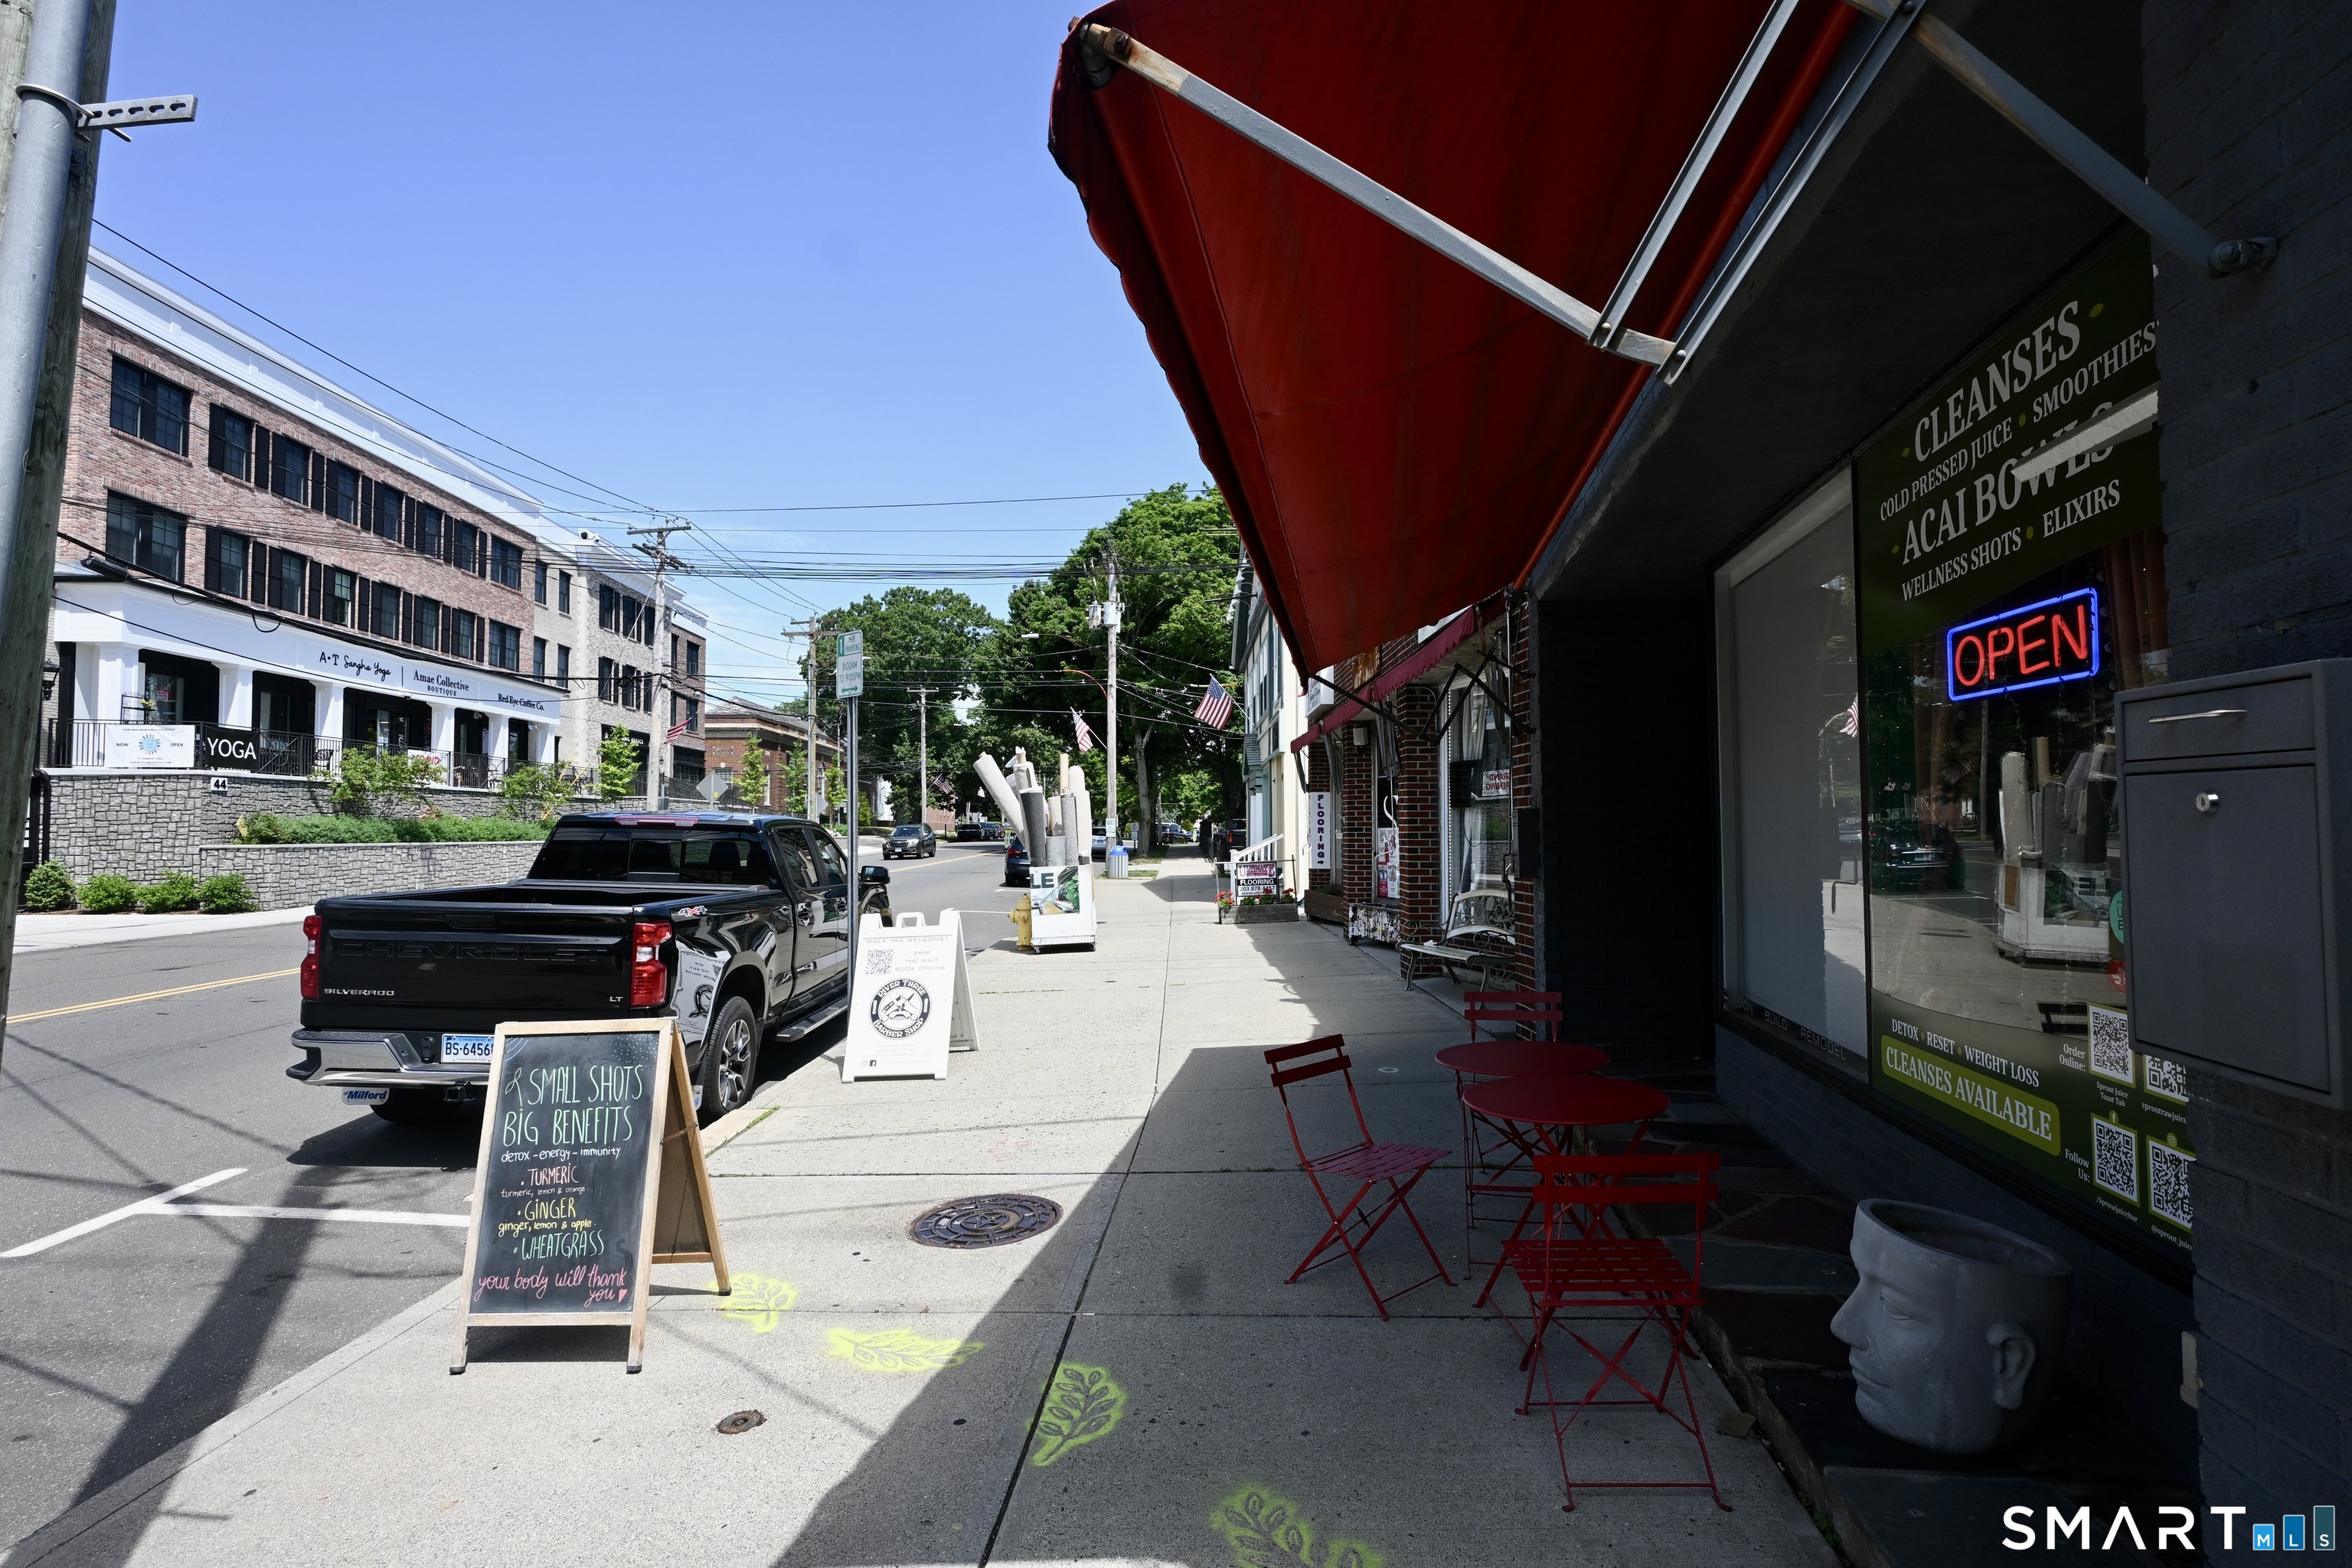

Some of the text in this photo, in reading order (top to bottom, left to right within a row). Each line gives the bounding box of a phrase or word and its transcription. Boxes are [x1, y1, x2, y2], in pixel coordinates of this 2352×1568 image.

[1915, 300, 2080, 462] CLEANSES
[2033, 321, 2156, 423] SMOOTHIES
[1880, 417, 2012, 521] COLD PRESSED JUICE
[2043, 479, 2121, 537] ELIXIRS
[1903, 487, 1968, 564] ACAI
[1901, 528, 2022, 602] WELLNESS SHOTS
[845, 643, 860, 653] PARKING
[1955, 604, 2087, 687] OPEN
[344, 655, 372, 675] Sangha
[374, 662, 391, 681] Yoga
[413, 670, 469, 691] Amae Collective
[839, 675, 844, 683] TO
[427, 685, 457, 697] BOUTIQUE
[498, 693, 508, 703] Red
[519, 698, 536, 709] Coffee
[207, 737, 256, 760] YOGA
[214, 779, 227, 789] 44
[1317, 794, 1325, 859] FLOORING
[338, 941, 608, 962] CHEVROLET
[324, 988, 395, 997] SILVERADO
[877, 979, 926, 998] RIVER THREE
[1730, 994, 1753, 1014] DESIGN
[873, 1018, 924, 1038] BARBER SHOP
[1765, 1010, 1788, 1031] BUILD
[1800, 1027, 1846, 1060] REMODEL
[1892, 1018, 2040, 1088] DETOX RESET WEIGHT LOSS
[2063, 1043, 2086, 1060] Order
[2059, 1054, 2086, 1073] Online:
[347, 1090, 388, 1099] Milford
[527, 1064, 644, 1106] SMALL SHOTS
[1886, 1046, 2053, 1141] CLEANSES AVAILABLE
[2096, 1081, 2128, 1099] Sprout Juice
[2099, 1093, 2125, 1107] Toast Tab
[580, 1146, 621, 1160] immunity
[2065, 1148, 2090, 1168] Follow
[2078, 1168, 2090, 1183] Us:
[537, 1187, 556, 1195] lemon
[534, 1221, 557, 1230] lemon
[561, 1221, 567, 1230] &
[522, 1230, 604, 1259] WHEATGRASS
[474, 1266, 628, 1301] your body will thank
[584, 1289, 616, 1307] you
